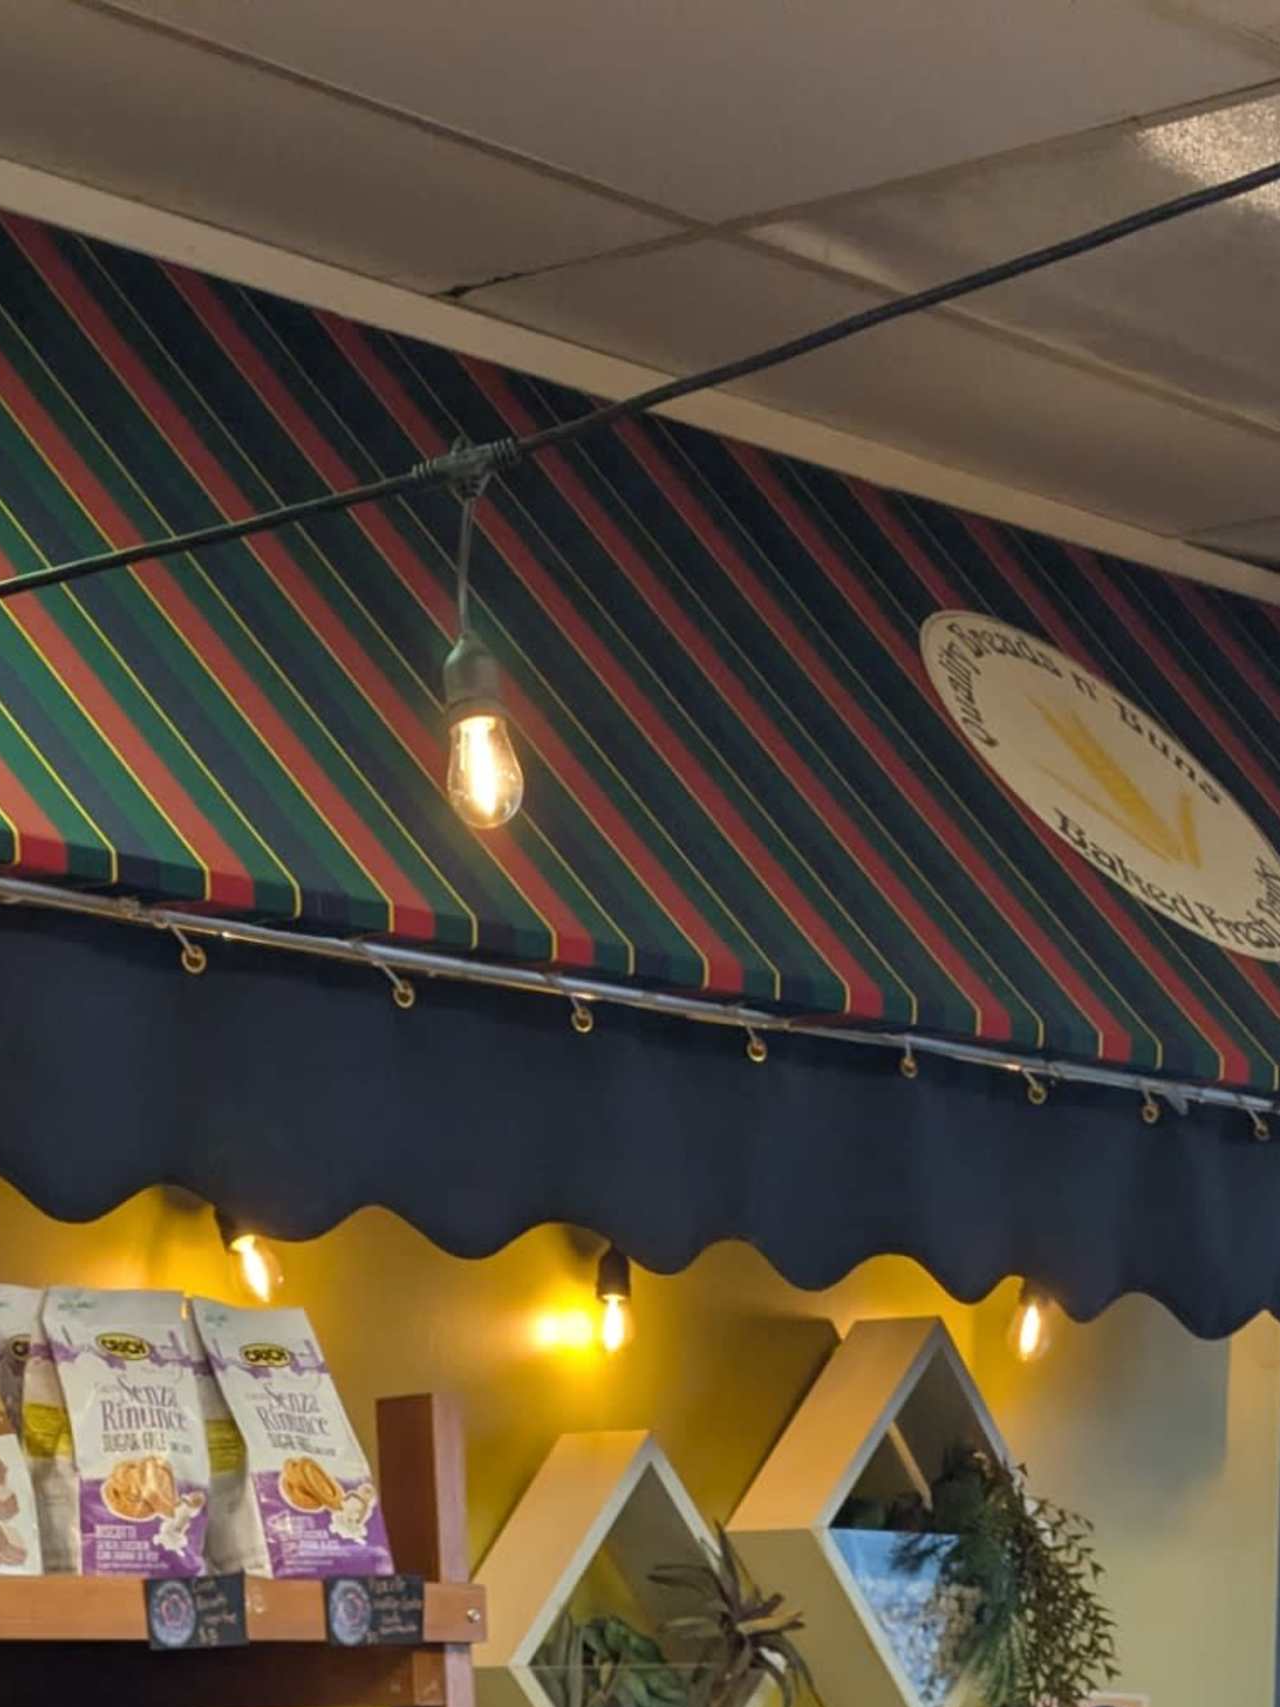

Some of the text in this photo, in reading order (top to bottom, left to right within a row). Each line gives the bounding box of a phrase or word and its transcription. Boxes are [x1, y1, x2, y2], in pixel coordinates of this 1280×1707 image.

[938, 642, 1000, 748] Quality
[947, 622, 1063, 679] Breads
[1110, 697, 1221, 805] Buns
[1054, 806, 1201, 929] Baked
